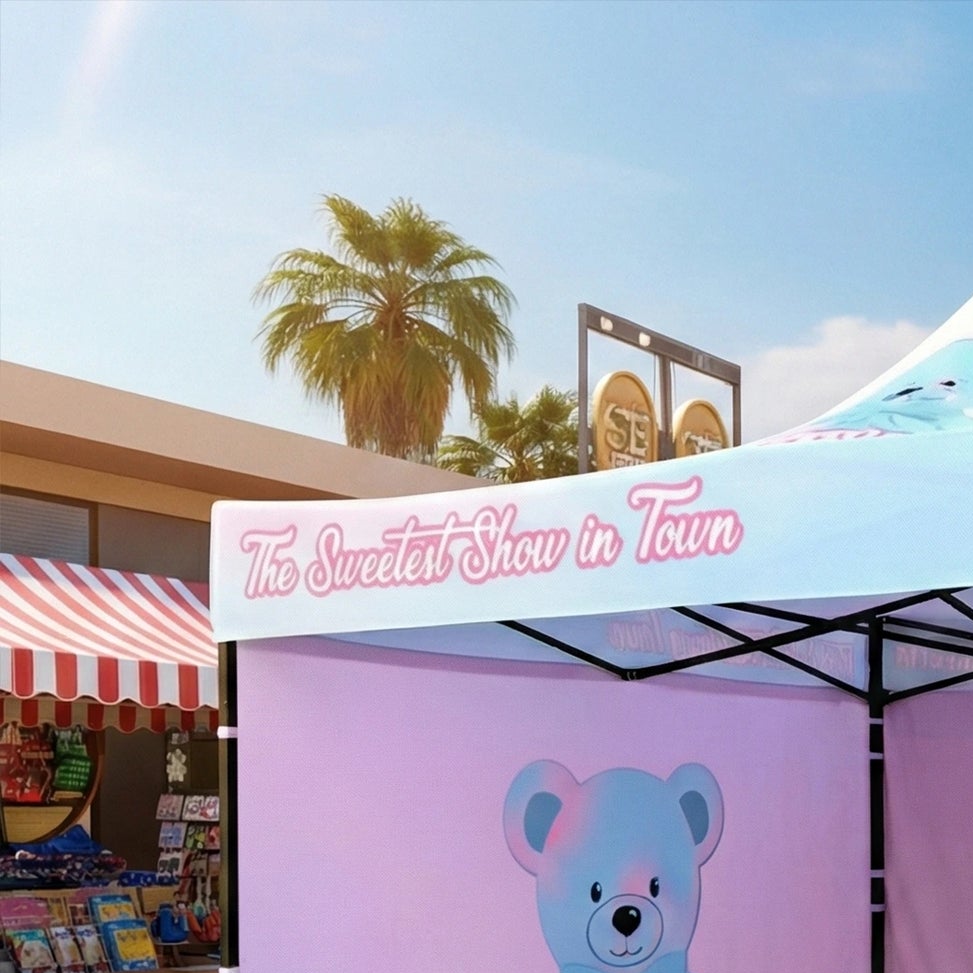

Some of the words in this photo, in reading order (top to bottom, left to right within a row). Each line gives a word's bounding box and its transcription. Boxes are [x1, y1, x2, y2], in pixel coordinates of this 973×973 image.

[241, 525, 299, 599] The
[304, 512, 460, 598] Sweetest
[459, 504, 570, 584] Show
[577, 514, 624, 569] in
[629, 475, 744, 564] Town
